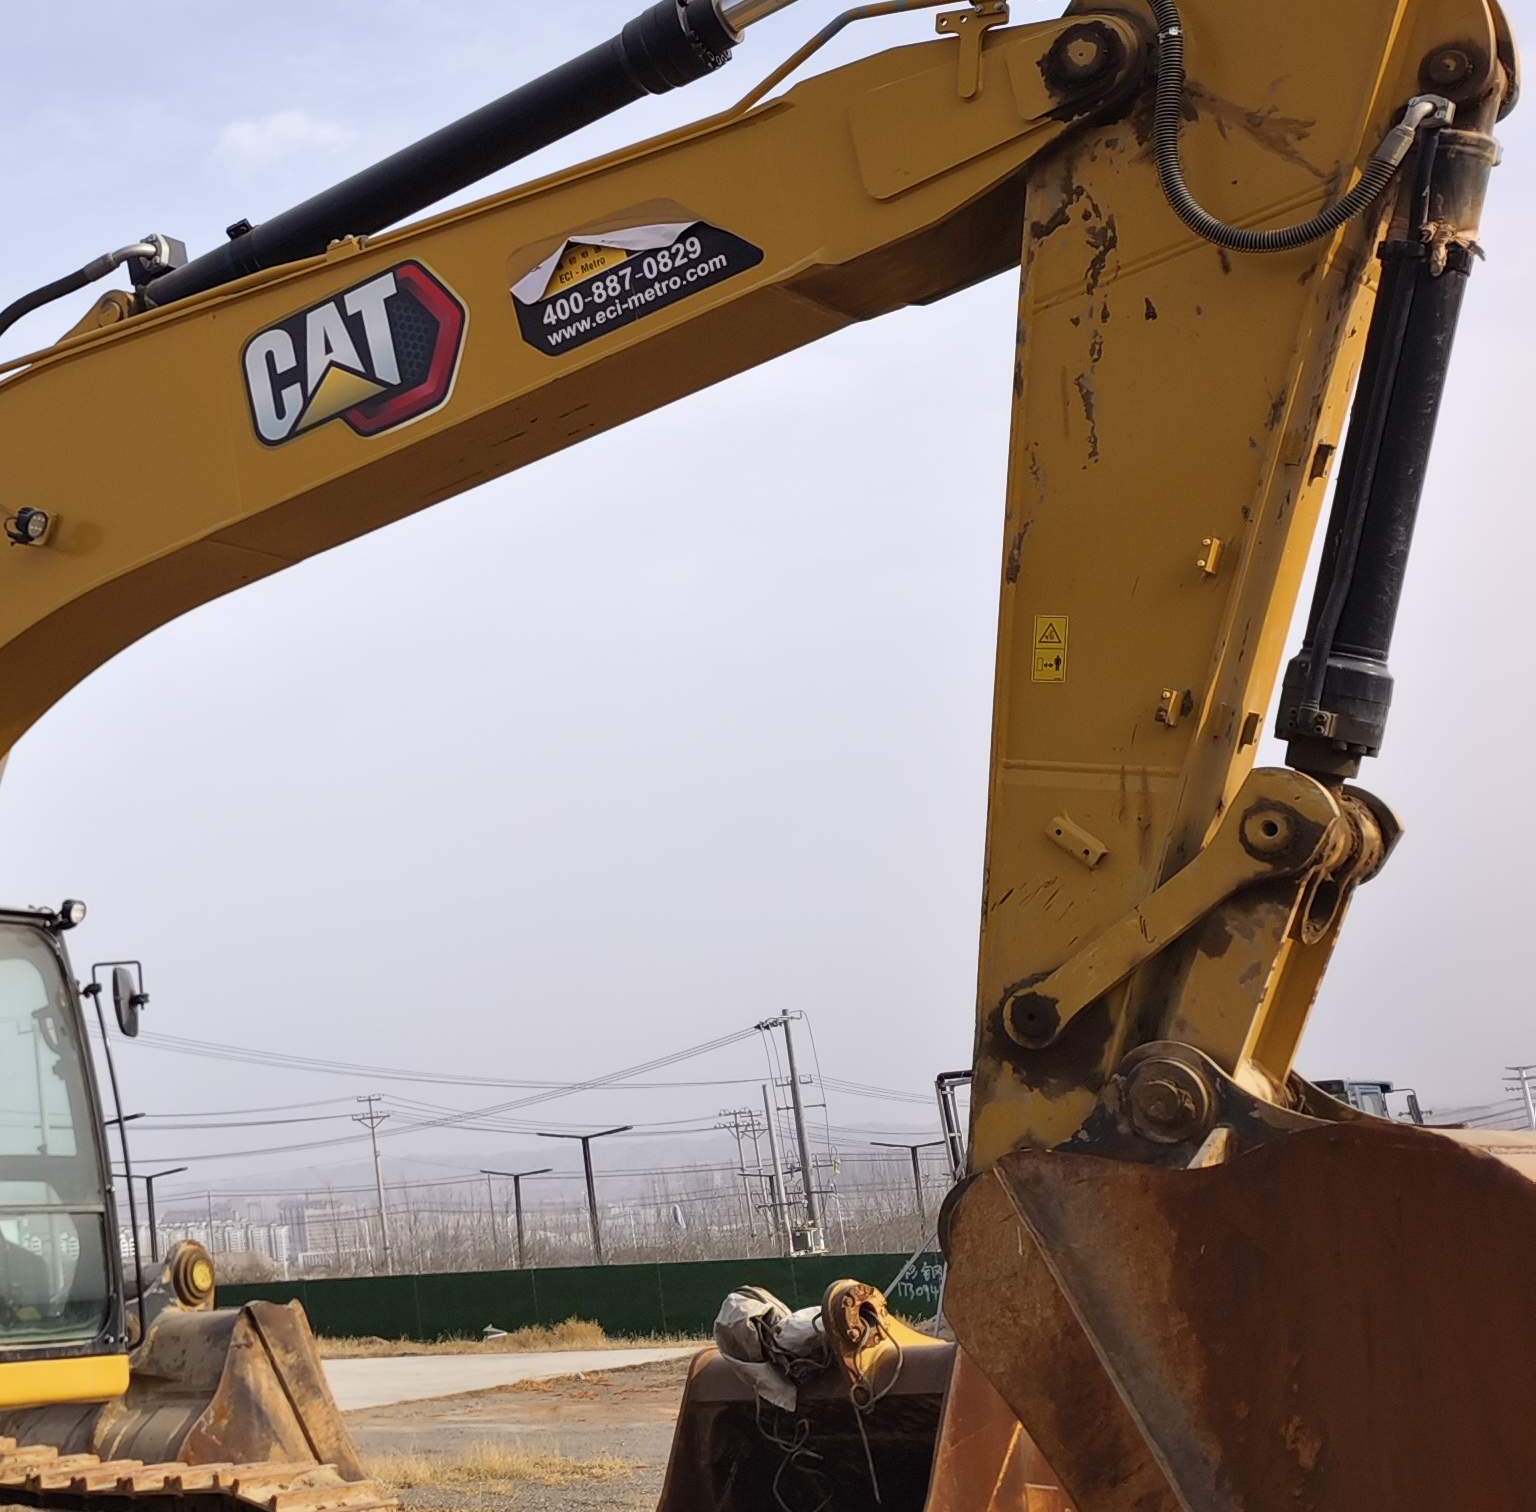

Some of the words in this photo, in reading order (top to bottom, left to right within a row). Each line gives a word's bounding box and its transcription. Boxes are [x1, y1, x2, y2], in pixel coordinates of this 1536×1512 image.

[542, 236, 702, 326] 400-887-0829
[547, 252, 728, 346] www.eci-metro.com
[559, 270, 574, 284] ECI
[580, 256, 606, 274] Metro
[244, 272, 403, 441] CAT
